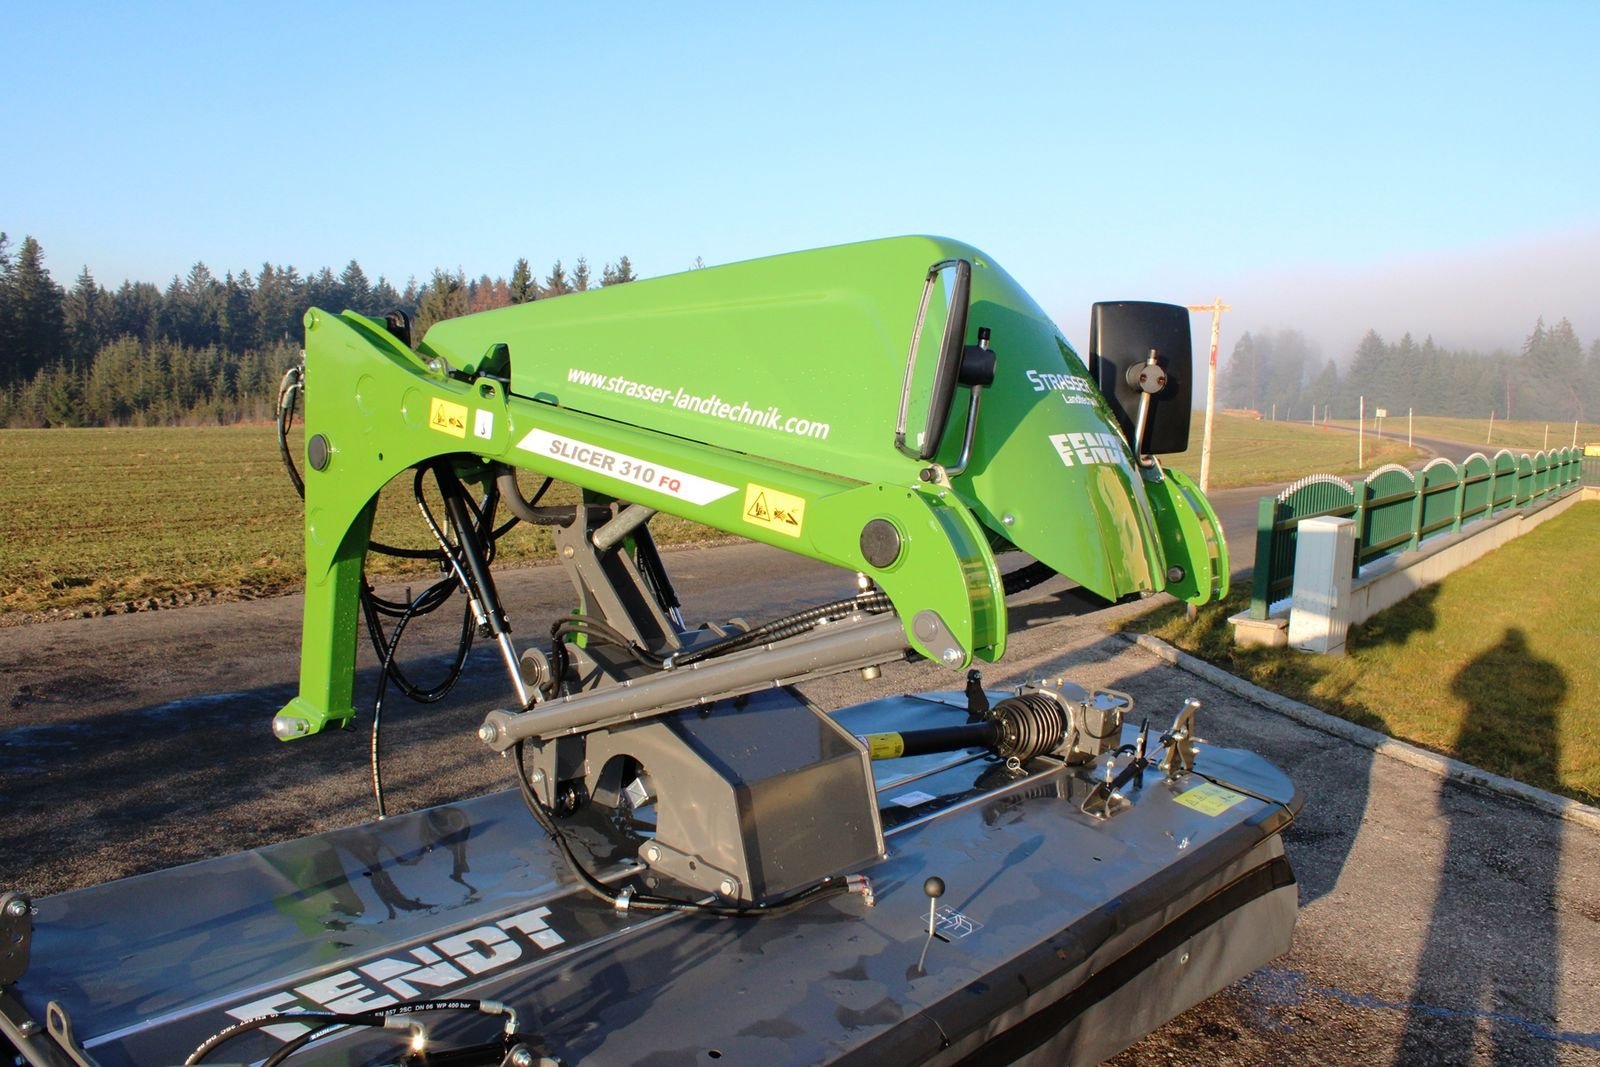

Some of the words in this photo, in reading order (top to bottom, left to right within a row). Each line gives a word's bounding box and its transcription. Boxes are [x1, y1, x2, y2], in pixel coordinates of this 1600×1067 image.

[568, 368, 830, 440] www.strasser-landtechnik.com
[549, 439, 616, 472] SLICER
[619, 460, 655, 484] 310
[658, 475, 682, 493] FQ
[225, 905, 565, 1043] FENDT
